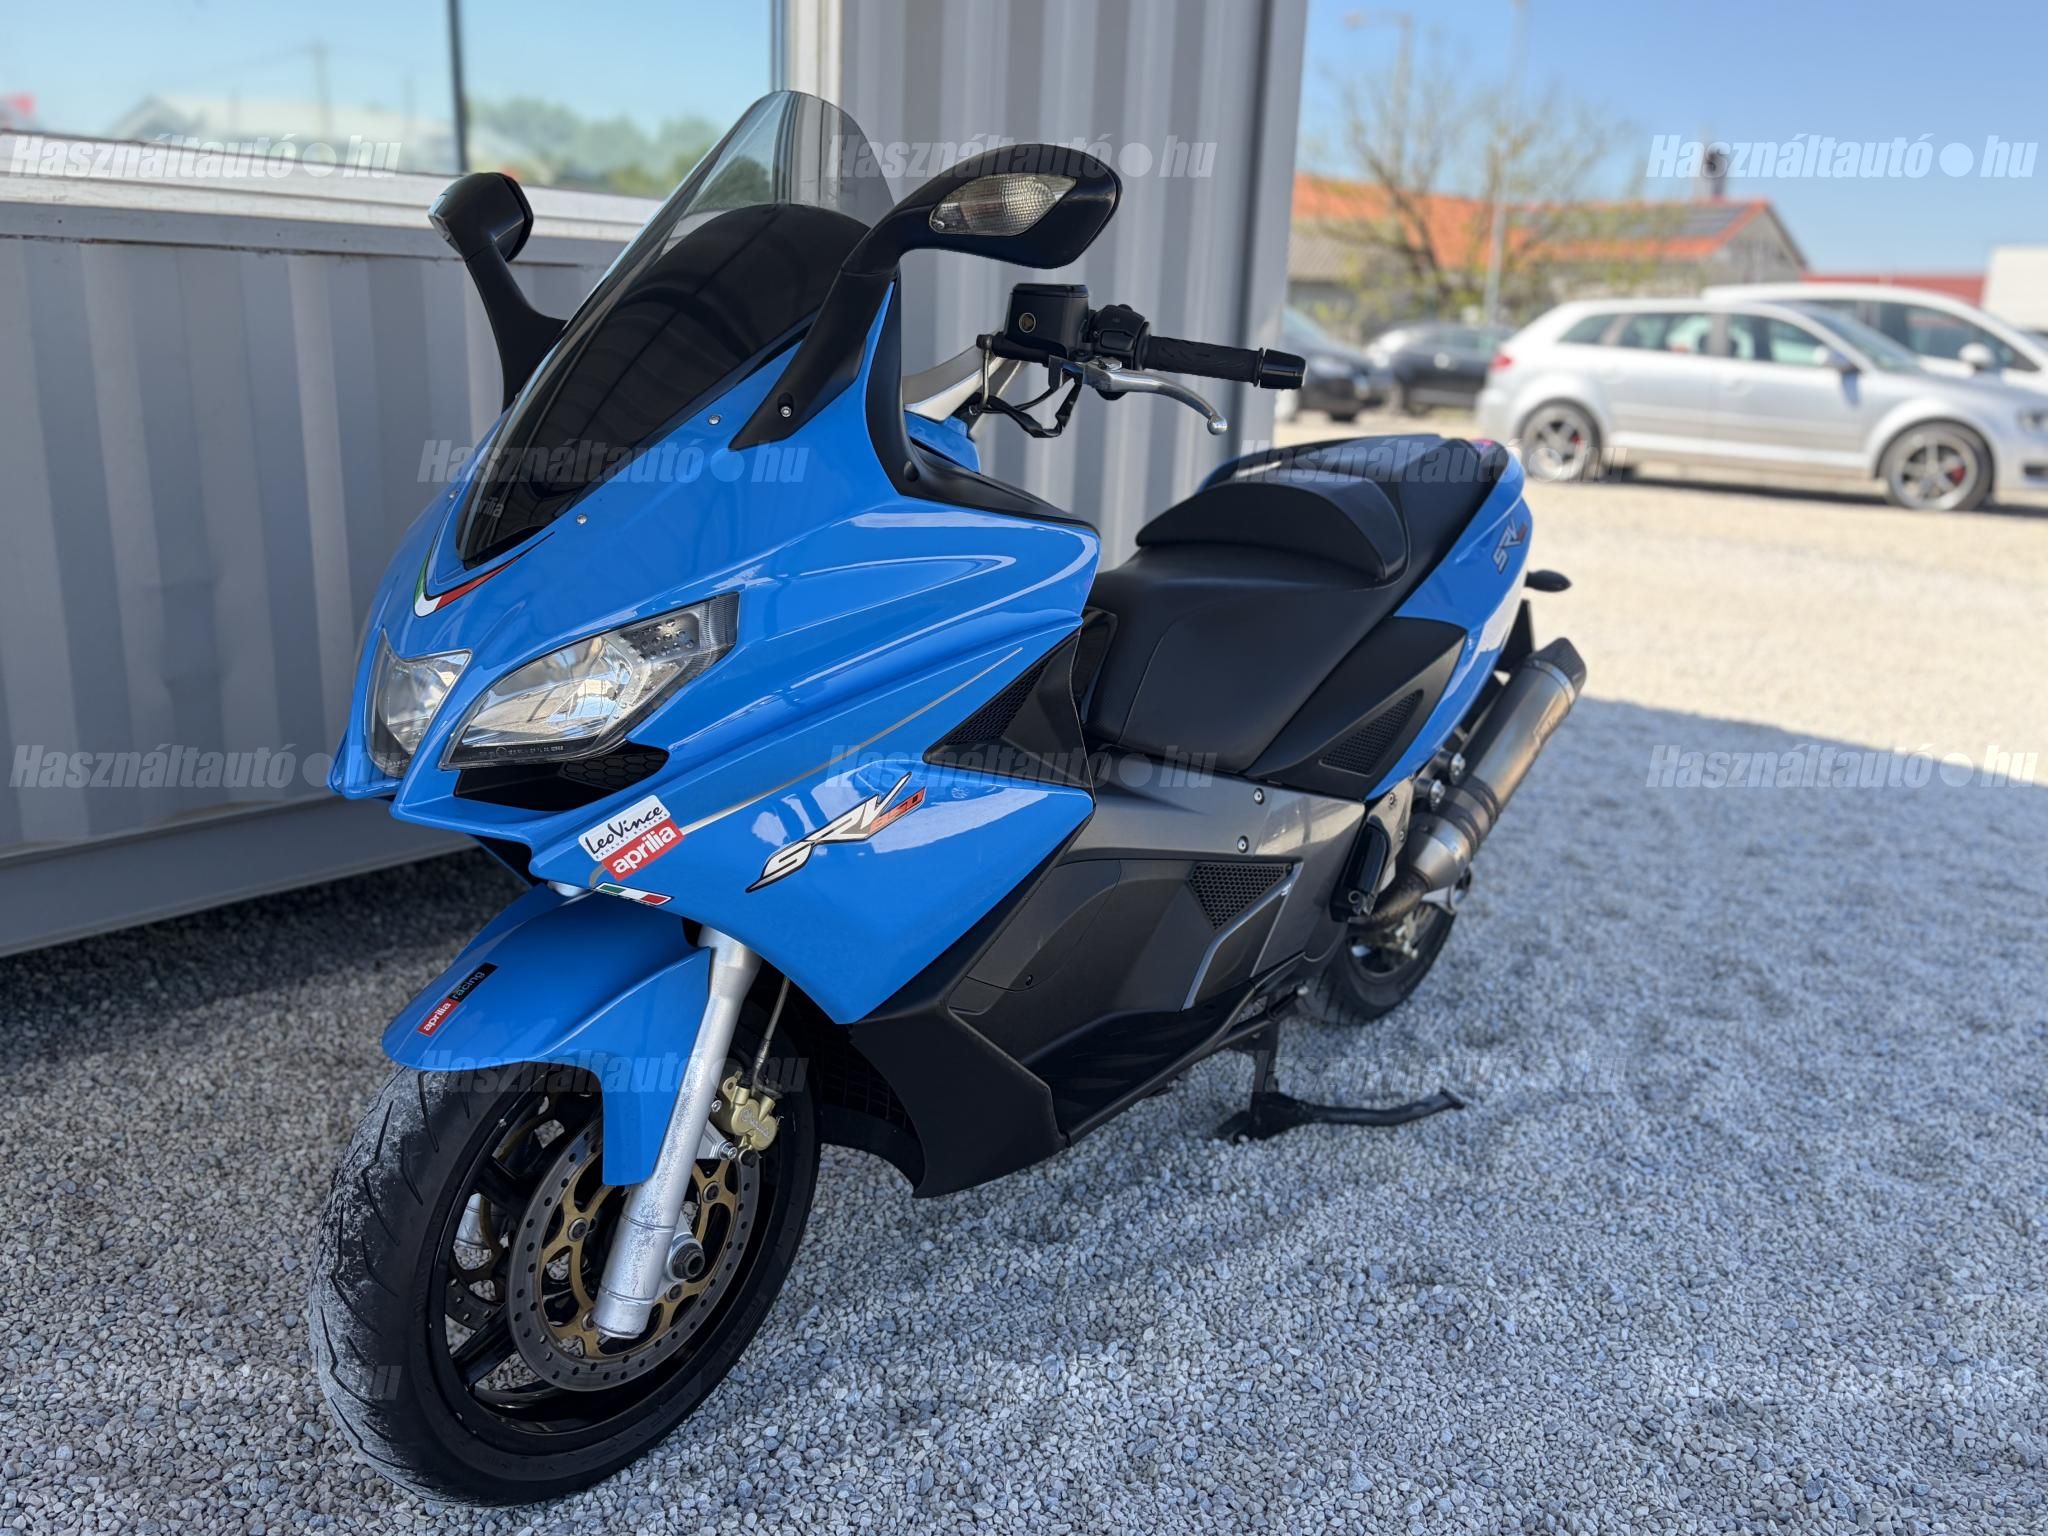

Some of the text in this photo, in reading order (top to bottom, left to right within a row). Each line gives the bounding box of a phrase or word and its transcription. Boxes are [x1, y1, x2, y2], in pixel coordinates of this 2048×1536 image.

[585, 806, 663, 855] LeoVince
[612, 826, 677, 874] aprilia
[745, 771, 912, 893] SRV
[424, 971, 485, 1031] aprilia racing
